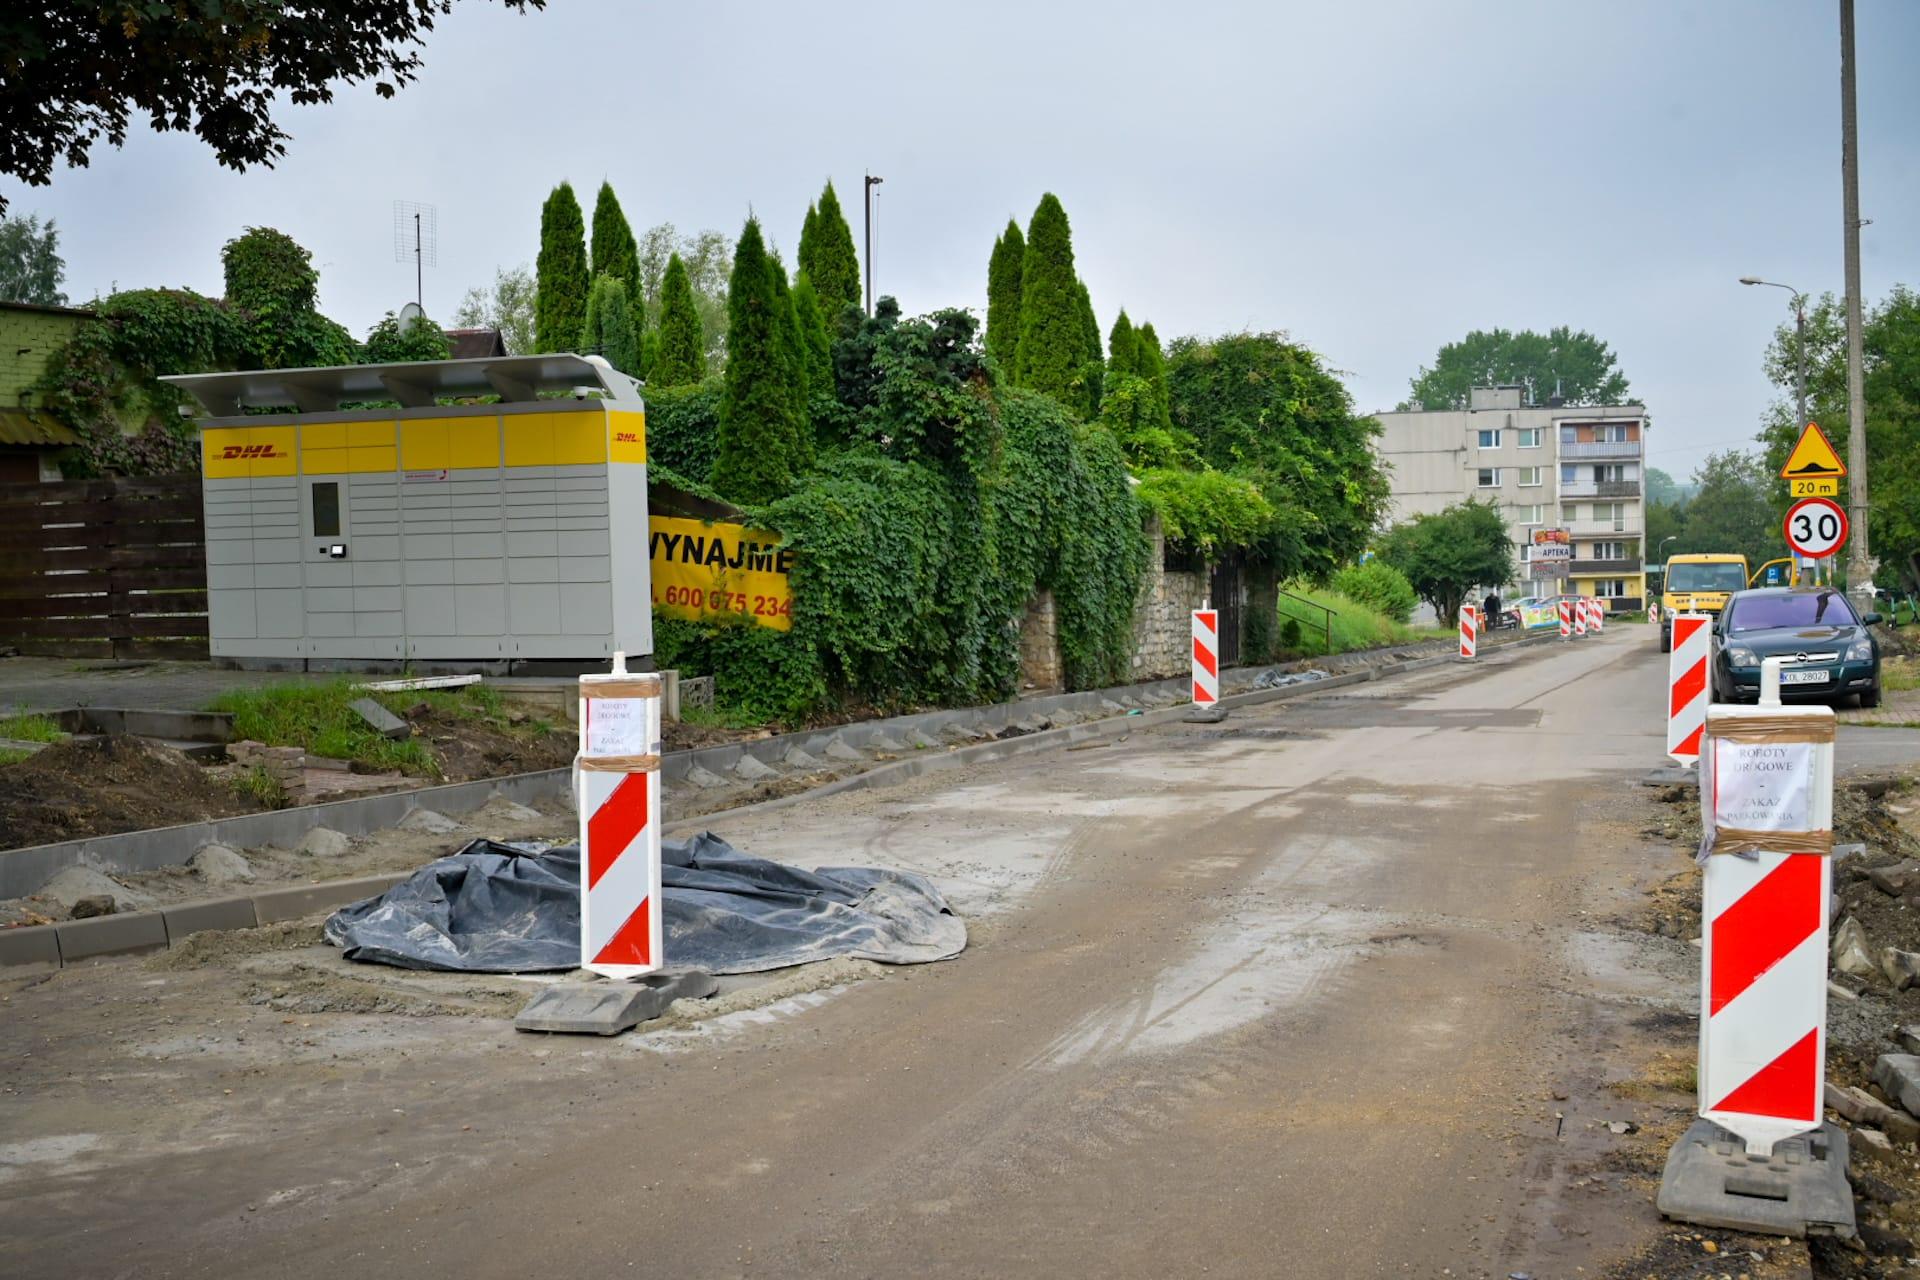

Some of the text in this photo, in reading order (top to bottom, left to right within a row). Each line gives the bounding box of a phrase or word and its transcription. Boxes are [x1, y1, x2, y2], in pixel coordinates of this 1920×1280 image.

[616, 432, 637, 442] DHL
[222, 445, 278, 459] DHL
[1797, 482, 1831, 493] 20 m
[1793, 514, 1838, 543] 30
[1542, 548, 1569, 557] APTEKA
[666, 585, 704, 608] 600
[754, 595, 791, 616] 234
[1802, 671, 1828, 681] 28027
